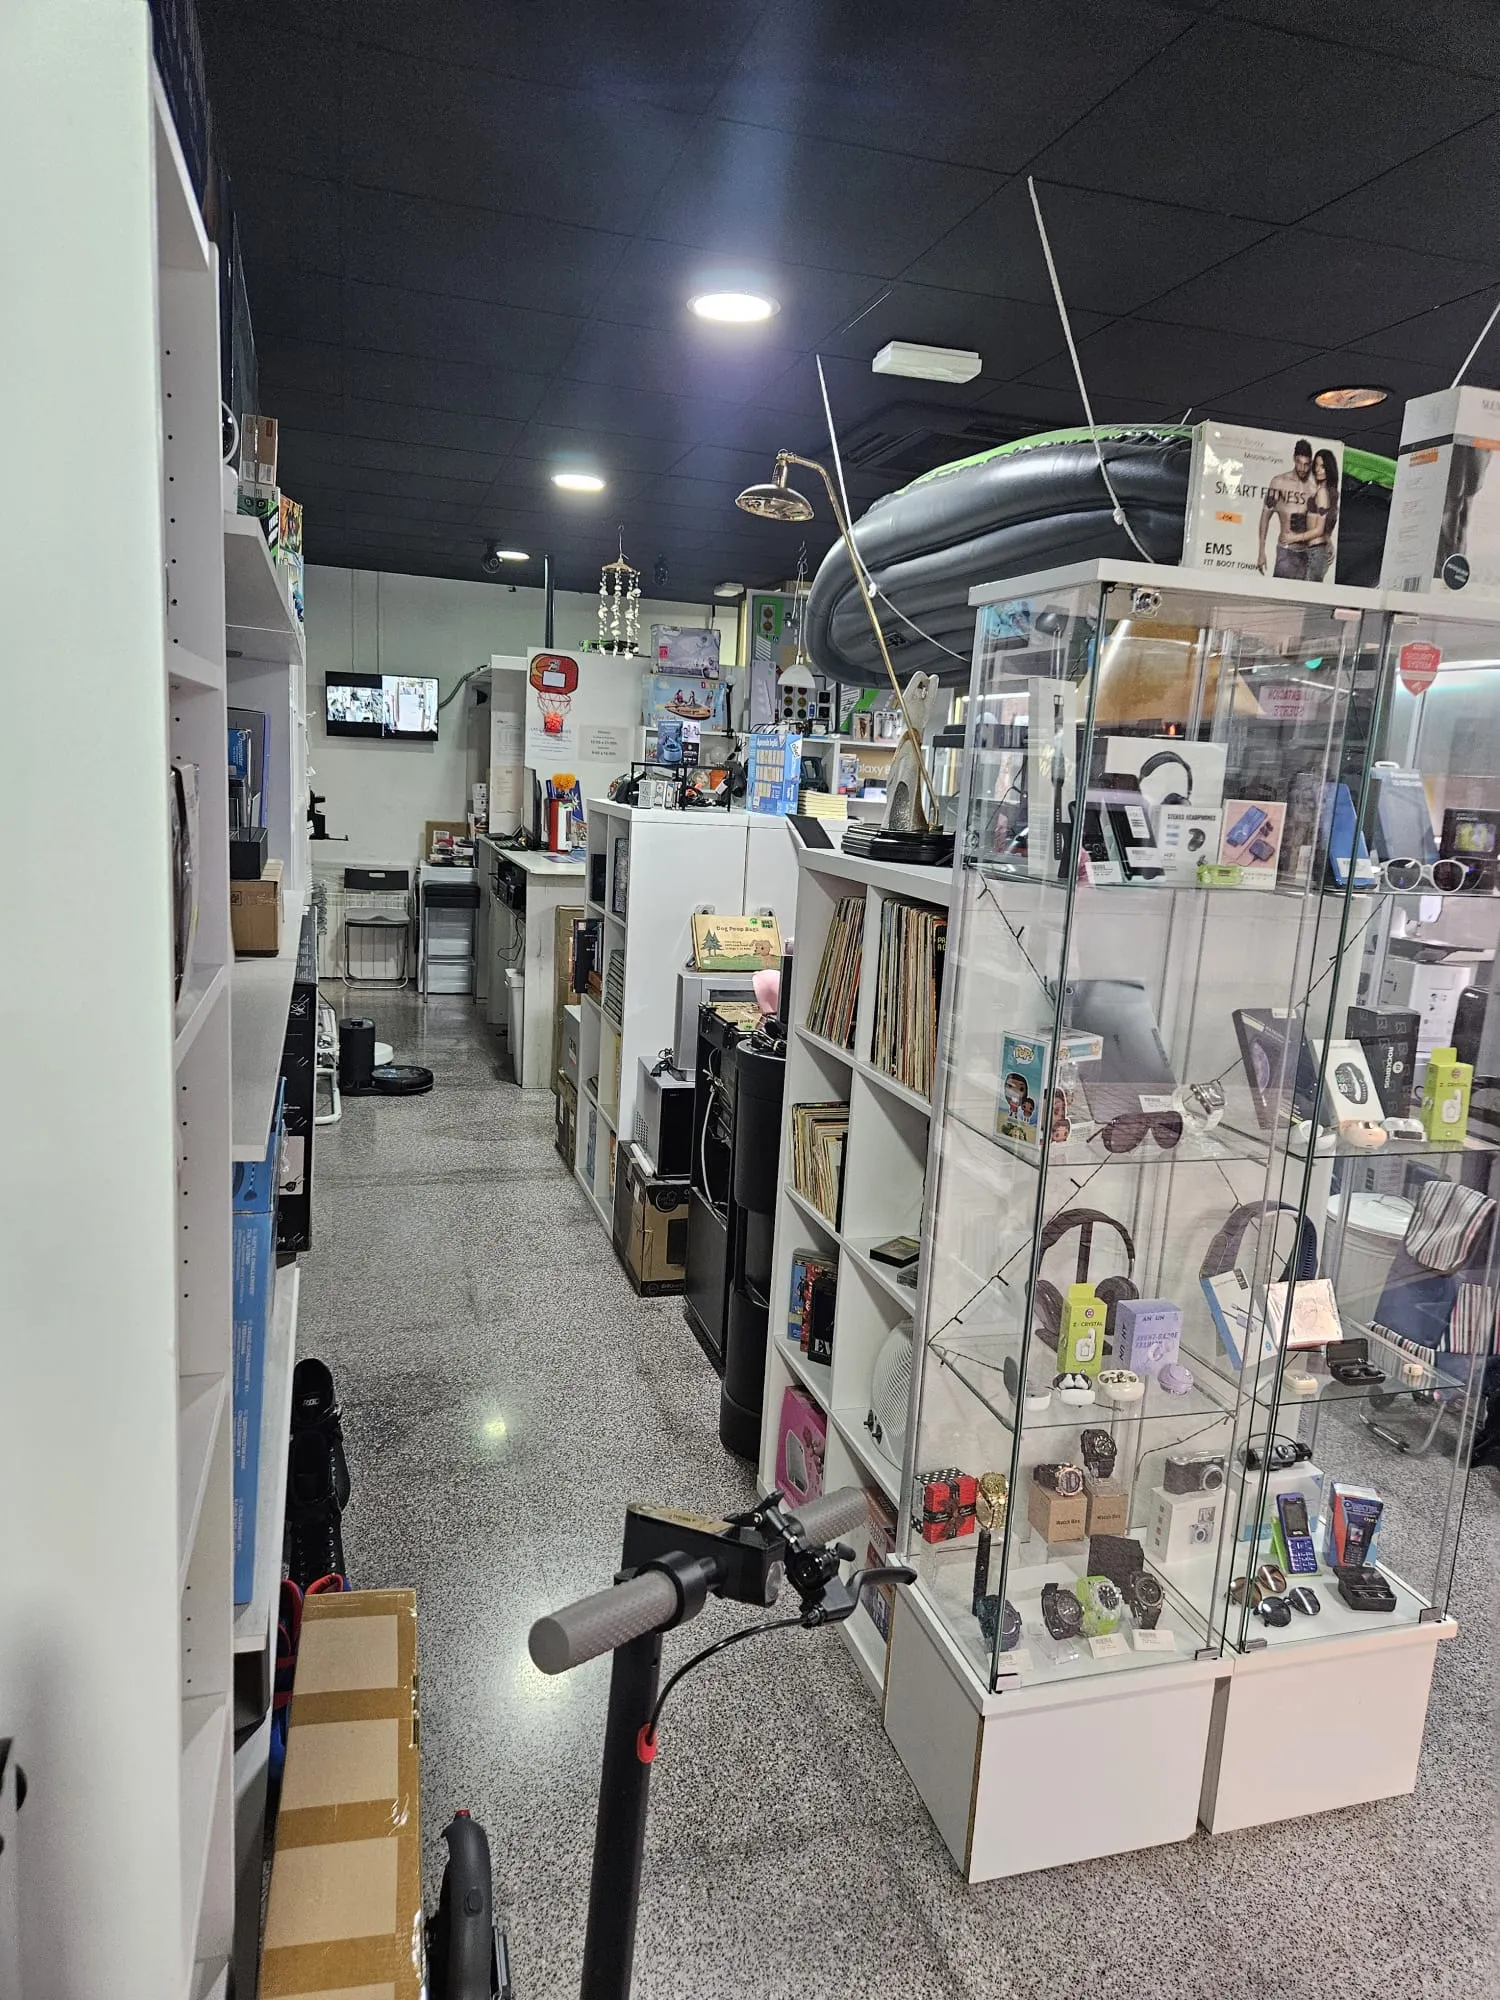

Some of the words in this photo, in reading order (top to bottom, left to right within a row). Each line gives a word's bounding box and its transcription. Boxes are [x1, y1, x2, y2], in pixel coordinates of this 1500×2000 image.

[1260, 487, 1306, 504] FITNESS
[1205, 542, 1232, 556] EMS
[1383, 1046, 1394, 1089] ROCKBROS
